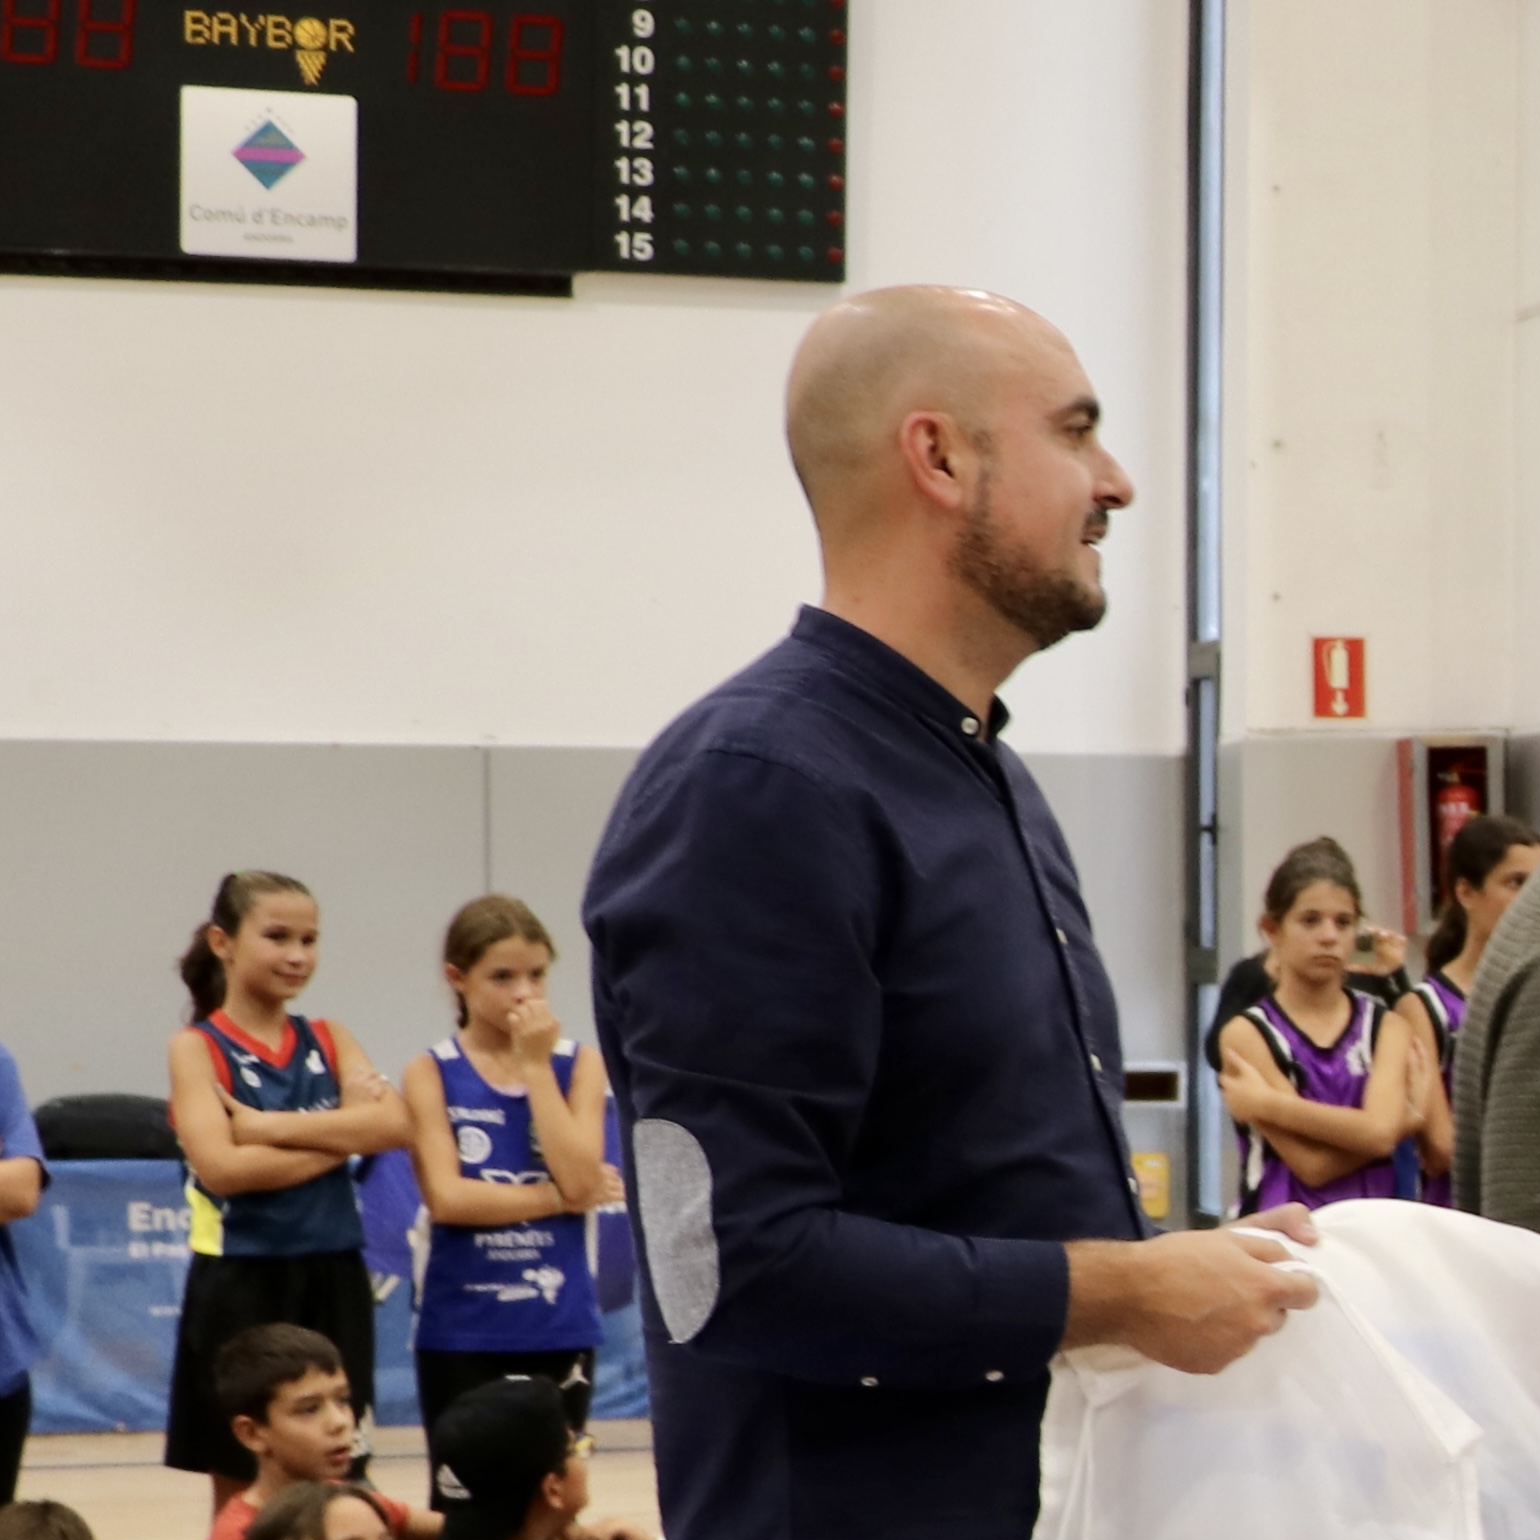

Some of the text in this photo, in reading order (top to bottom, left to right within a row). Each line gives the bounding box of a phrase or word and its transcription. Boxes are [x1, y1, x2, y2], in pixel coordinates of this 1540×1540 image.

[632, 8, 656, 39] 9
[615, 45, 656, 75] 10
[615, 82, 650, 112] 11
[615, 119, 655, 150] 12
[615, 156, 655, 187] 13
[615, 194, 655, 223] 14
[615, 230, 655, 262] 15
[127, 1201, 192, 1232] Enc
